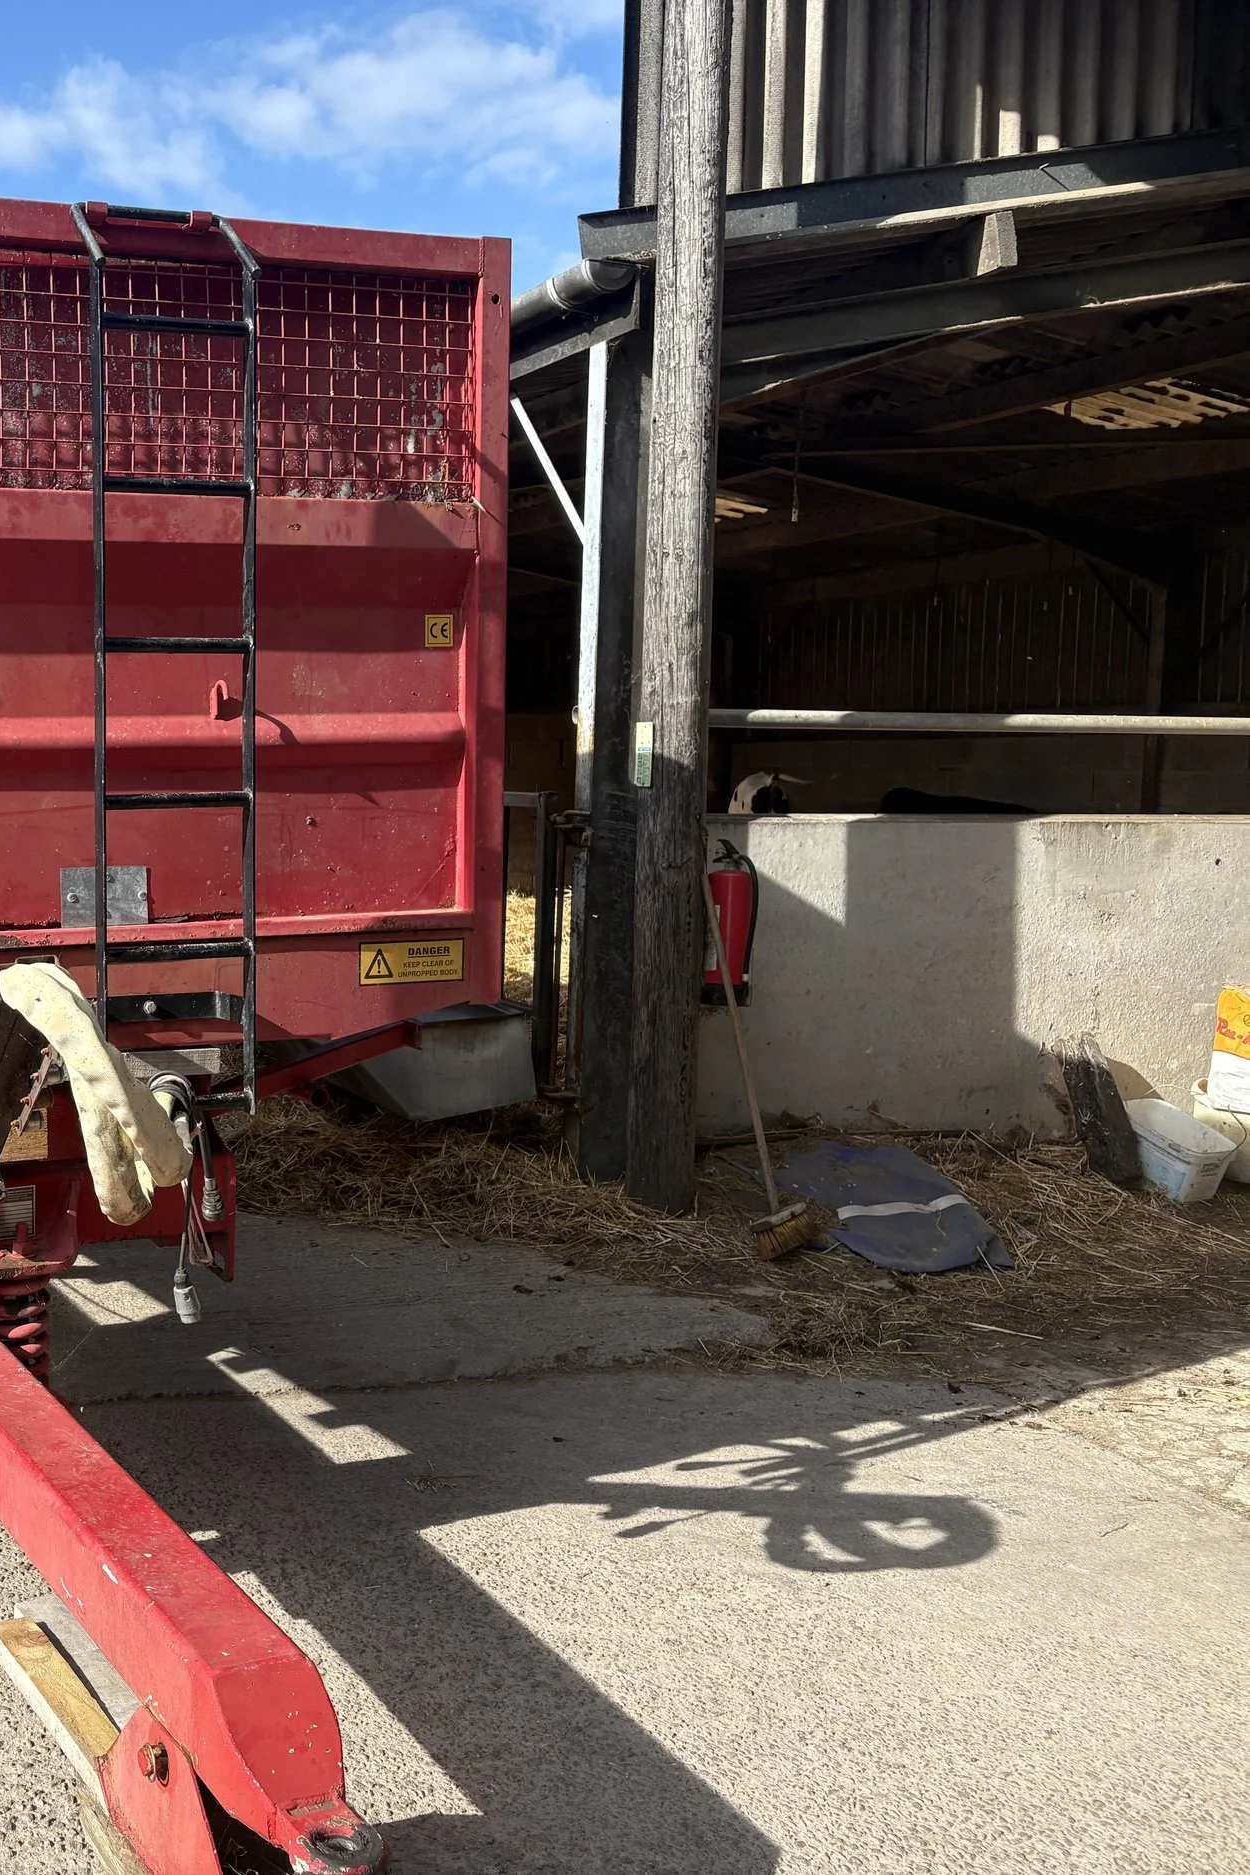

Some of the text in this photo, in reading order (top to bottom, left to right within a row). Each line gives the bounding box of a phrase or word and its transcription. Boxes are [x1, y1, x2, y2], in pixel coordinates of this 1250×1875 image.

[430, 622, 448, 639] CE
[407, 946, 450, 956] DANGER
[421, 959, 444, 968] CLEAR
[397, 969, 438, 978] UNPROPPED
